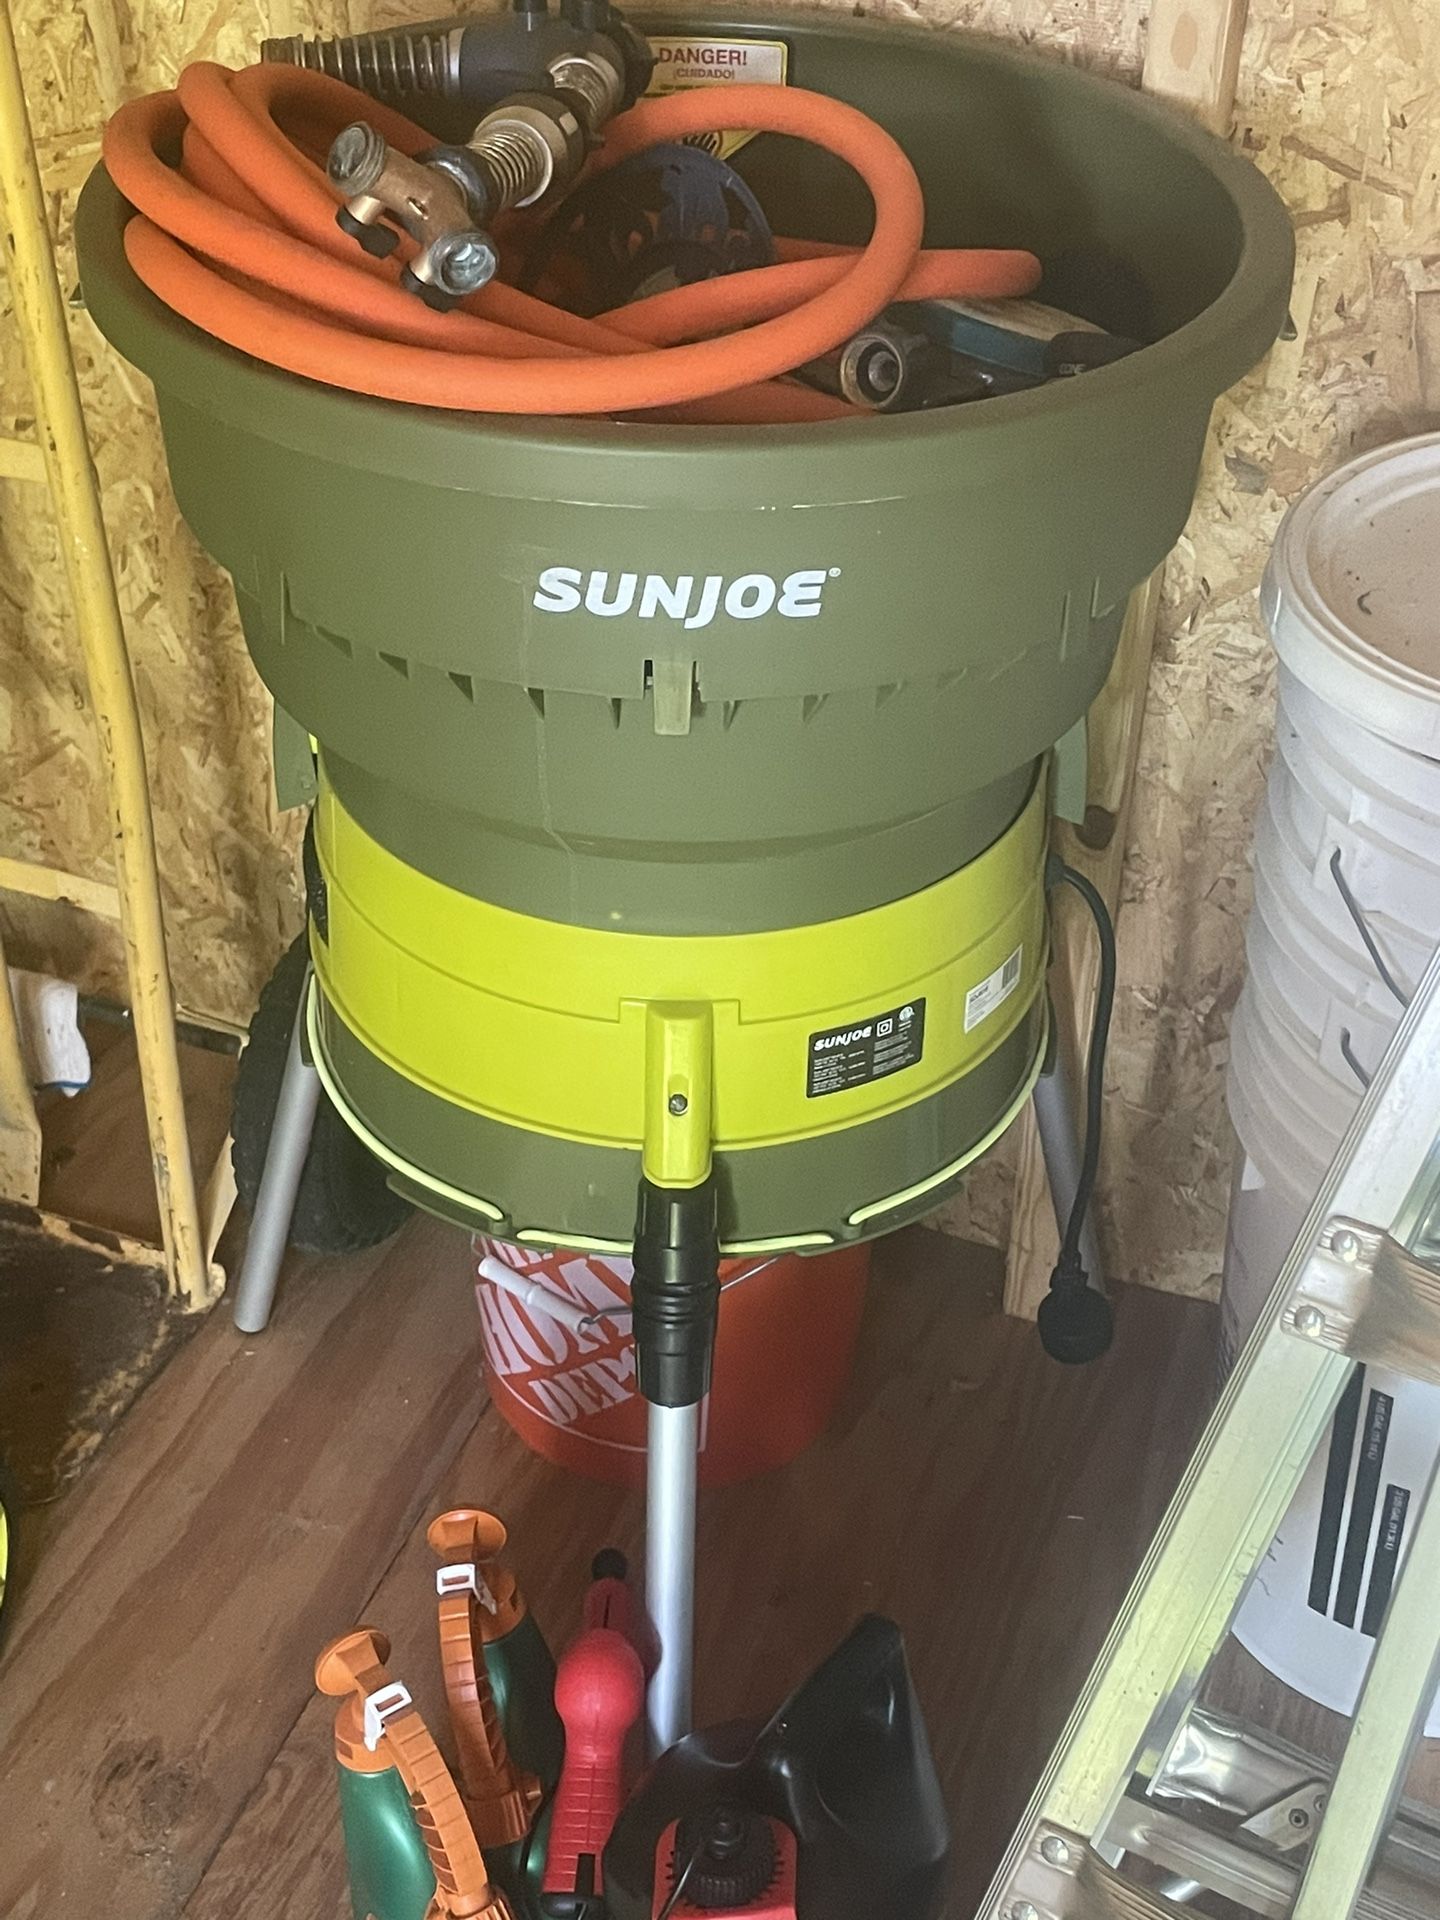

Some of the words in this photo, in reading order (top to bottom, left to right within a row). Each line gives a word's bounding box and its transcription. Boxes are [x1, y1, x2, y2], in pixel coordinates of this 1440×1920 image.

[659, 48, 747, 66] DANGER!
[475, 1255, 634, 1376] HOM
[527, 1346, 635, 1424] DEP
